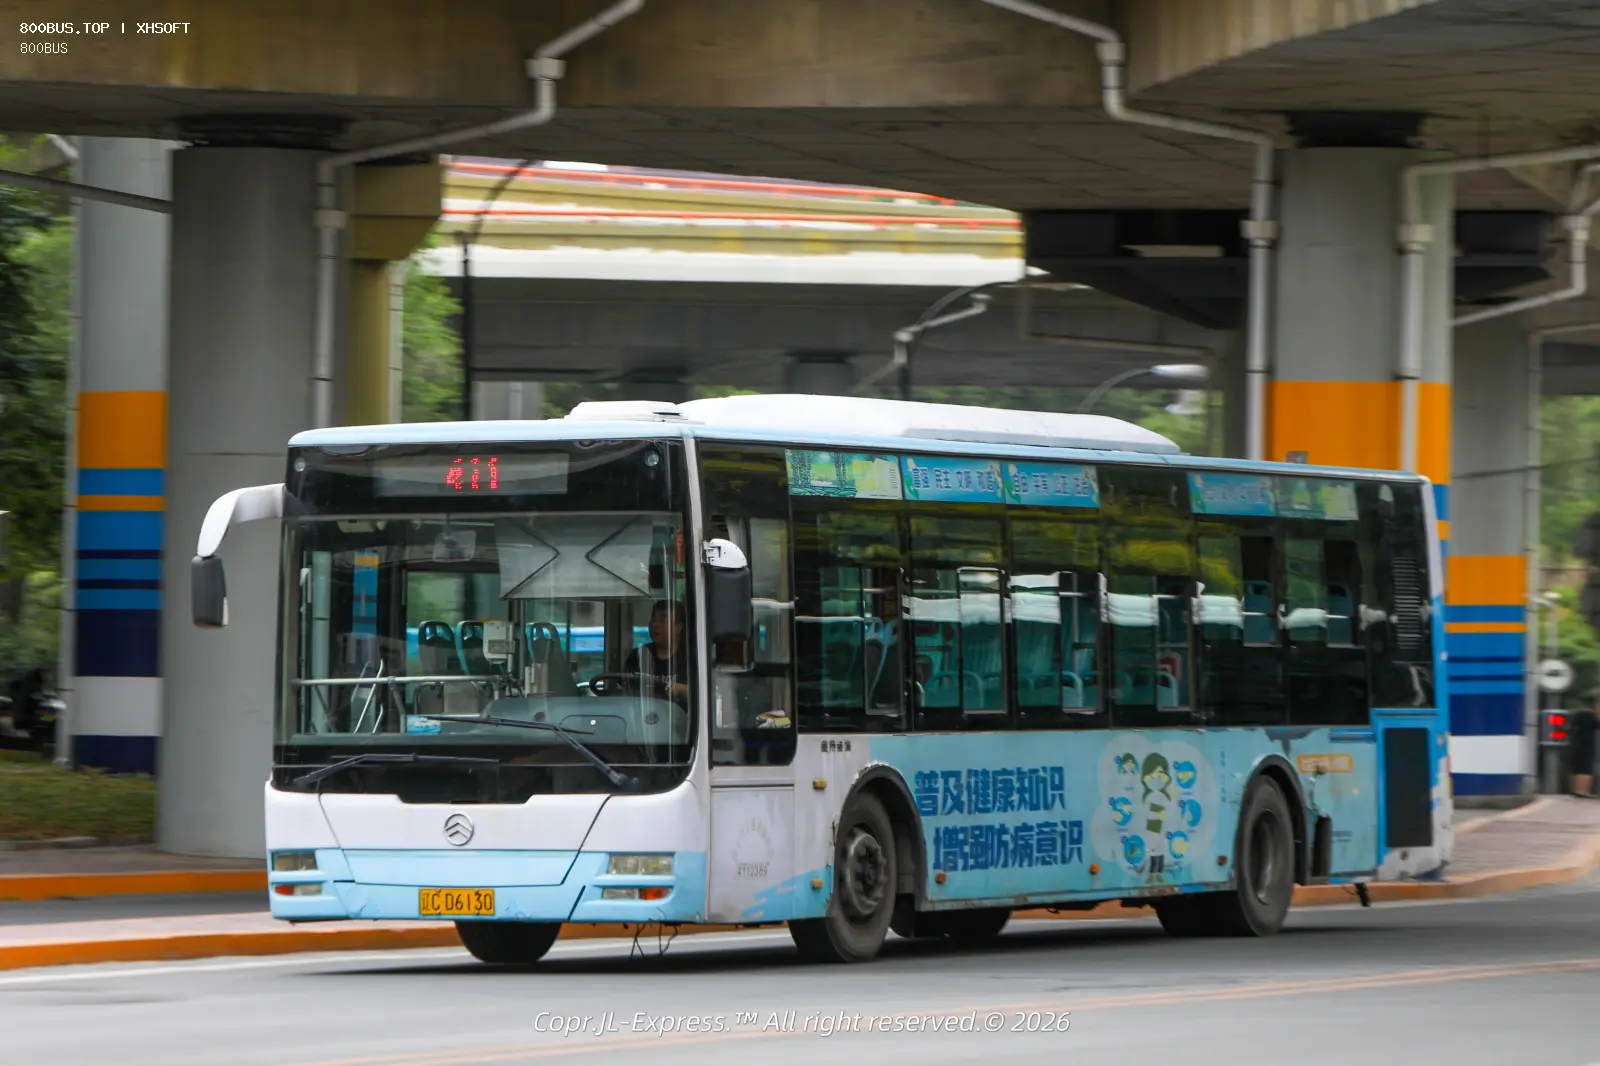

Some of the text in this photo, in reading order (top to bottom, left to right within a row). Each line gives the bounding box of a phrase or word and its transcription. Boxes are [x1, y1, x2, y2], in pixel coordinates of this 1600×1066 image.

[915, 766, 1065, 816] 普及健康知识
[933, 820, 1083, 872] 增强防病意识
